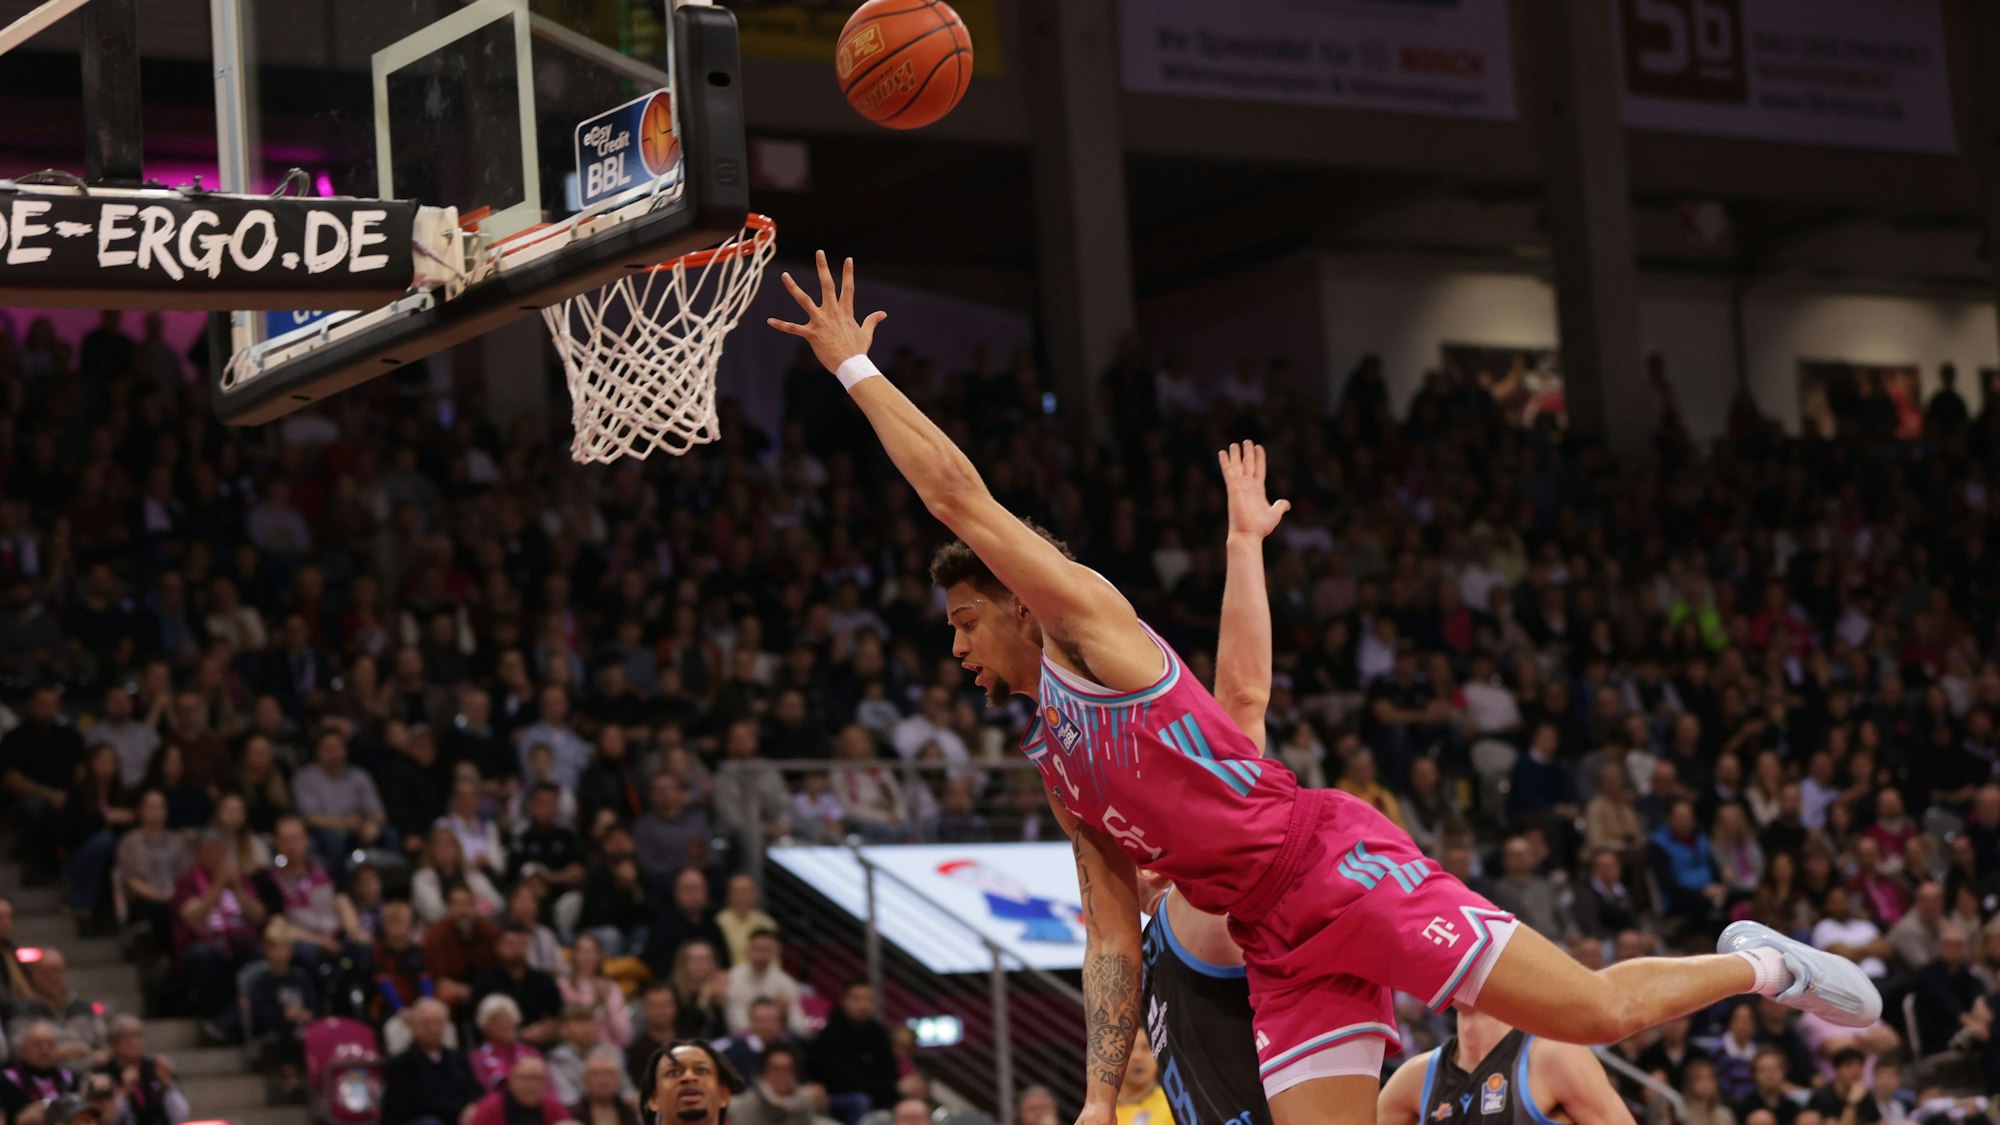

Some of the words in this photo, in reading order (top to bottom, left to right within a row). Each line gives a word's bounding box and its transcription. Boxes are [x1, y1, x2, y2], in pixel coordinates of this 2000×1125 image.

[1398, 44, 1486, 77] BOSCH
[597, 130, 631, 157] Credit
[586, 152, 632, 199] BBL
[0, 200, 390, 281] E-ERGO.DE
